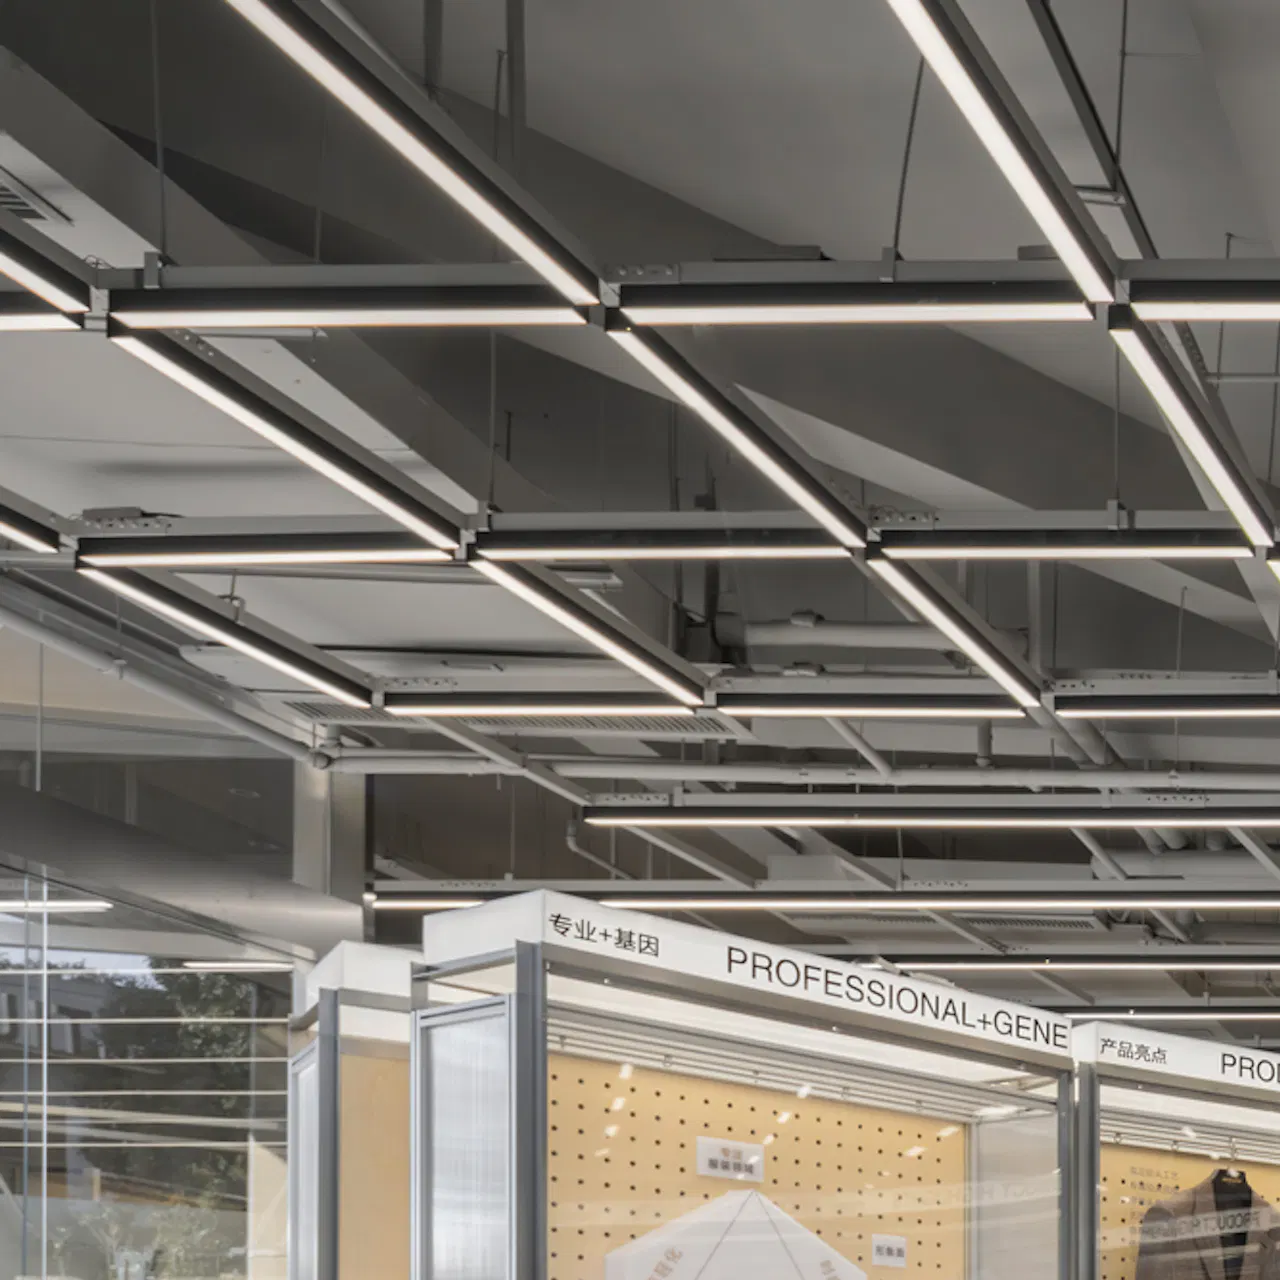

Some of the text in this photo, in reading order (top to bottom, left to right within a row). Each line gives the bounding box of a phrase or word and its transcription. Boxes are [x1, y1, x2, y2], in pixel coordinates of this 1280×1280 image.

[549, 911, 660, 958] 专业+基因
[725, 946, 1069, 1050] PROFESSIONAL+GENE
[1099, 1036, 1168, 1065] 产品亮点
